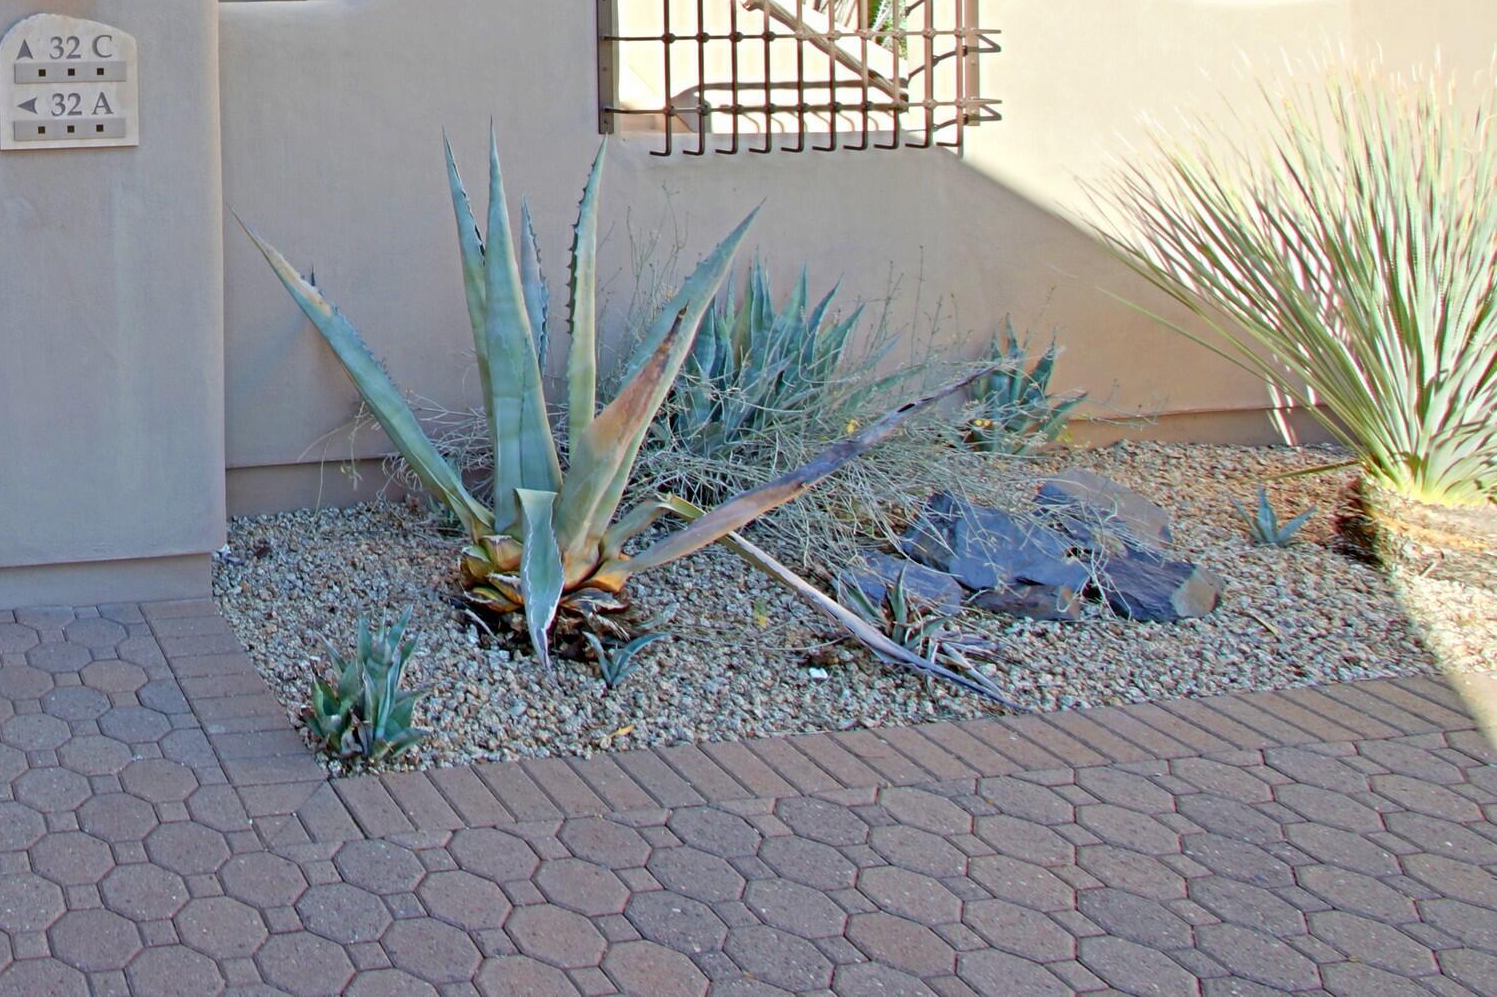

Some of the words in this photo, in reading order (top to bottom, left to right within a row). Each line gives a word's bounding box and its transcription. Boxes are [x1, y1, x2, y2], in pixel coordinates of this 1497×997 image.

[49, 36, 82, 60] 32
[92, 34, 113, 58] C
[50, 92, 83, 117] 32
[91, 91, 114, 115] A
